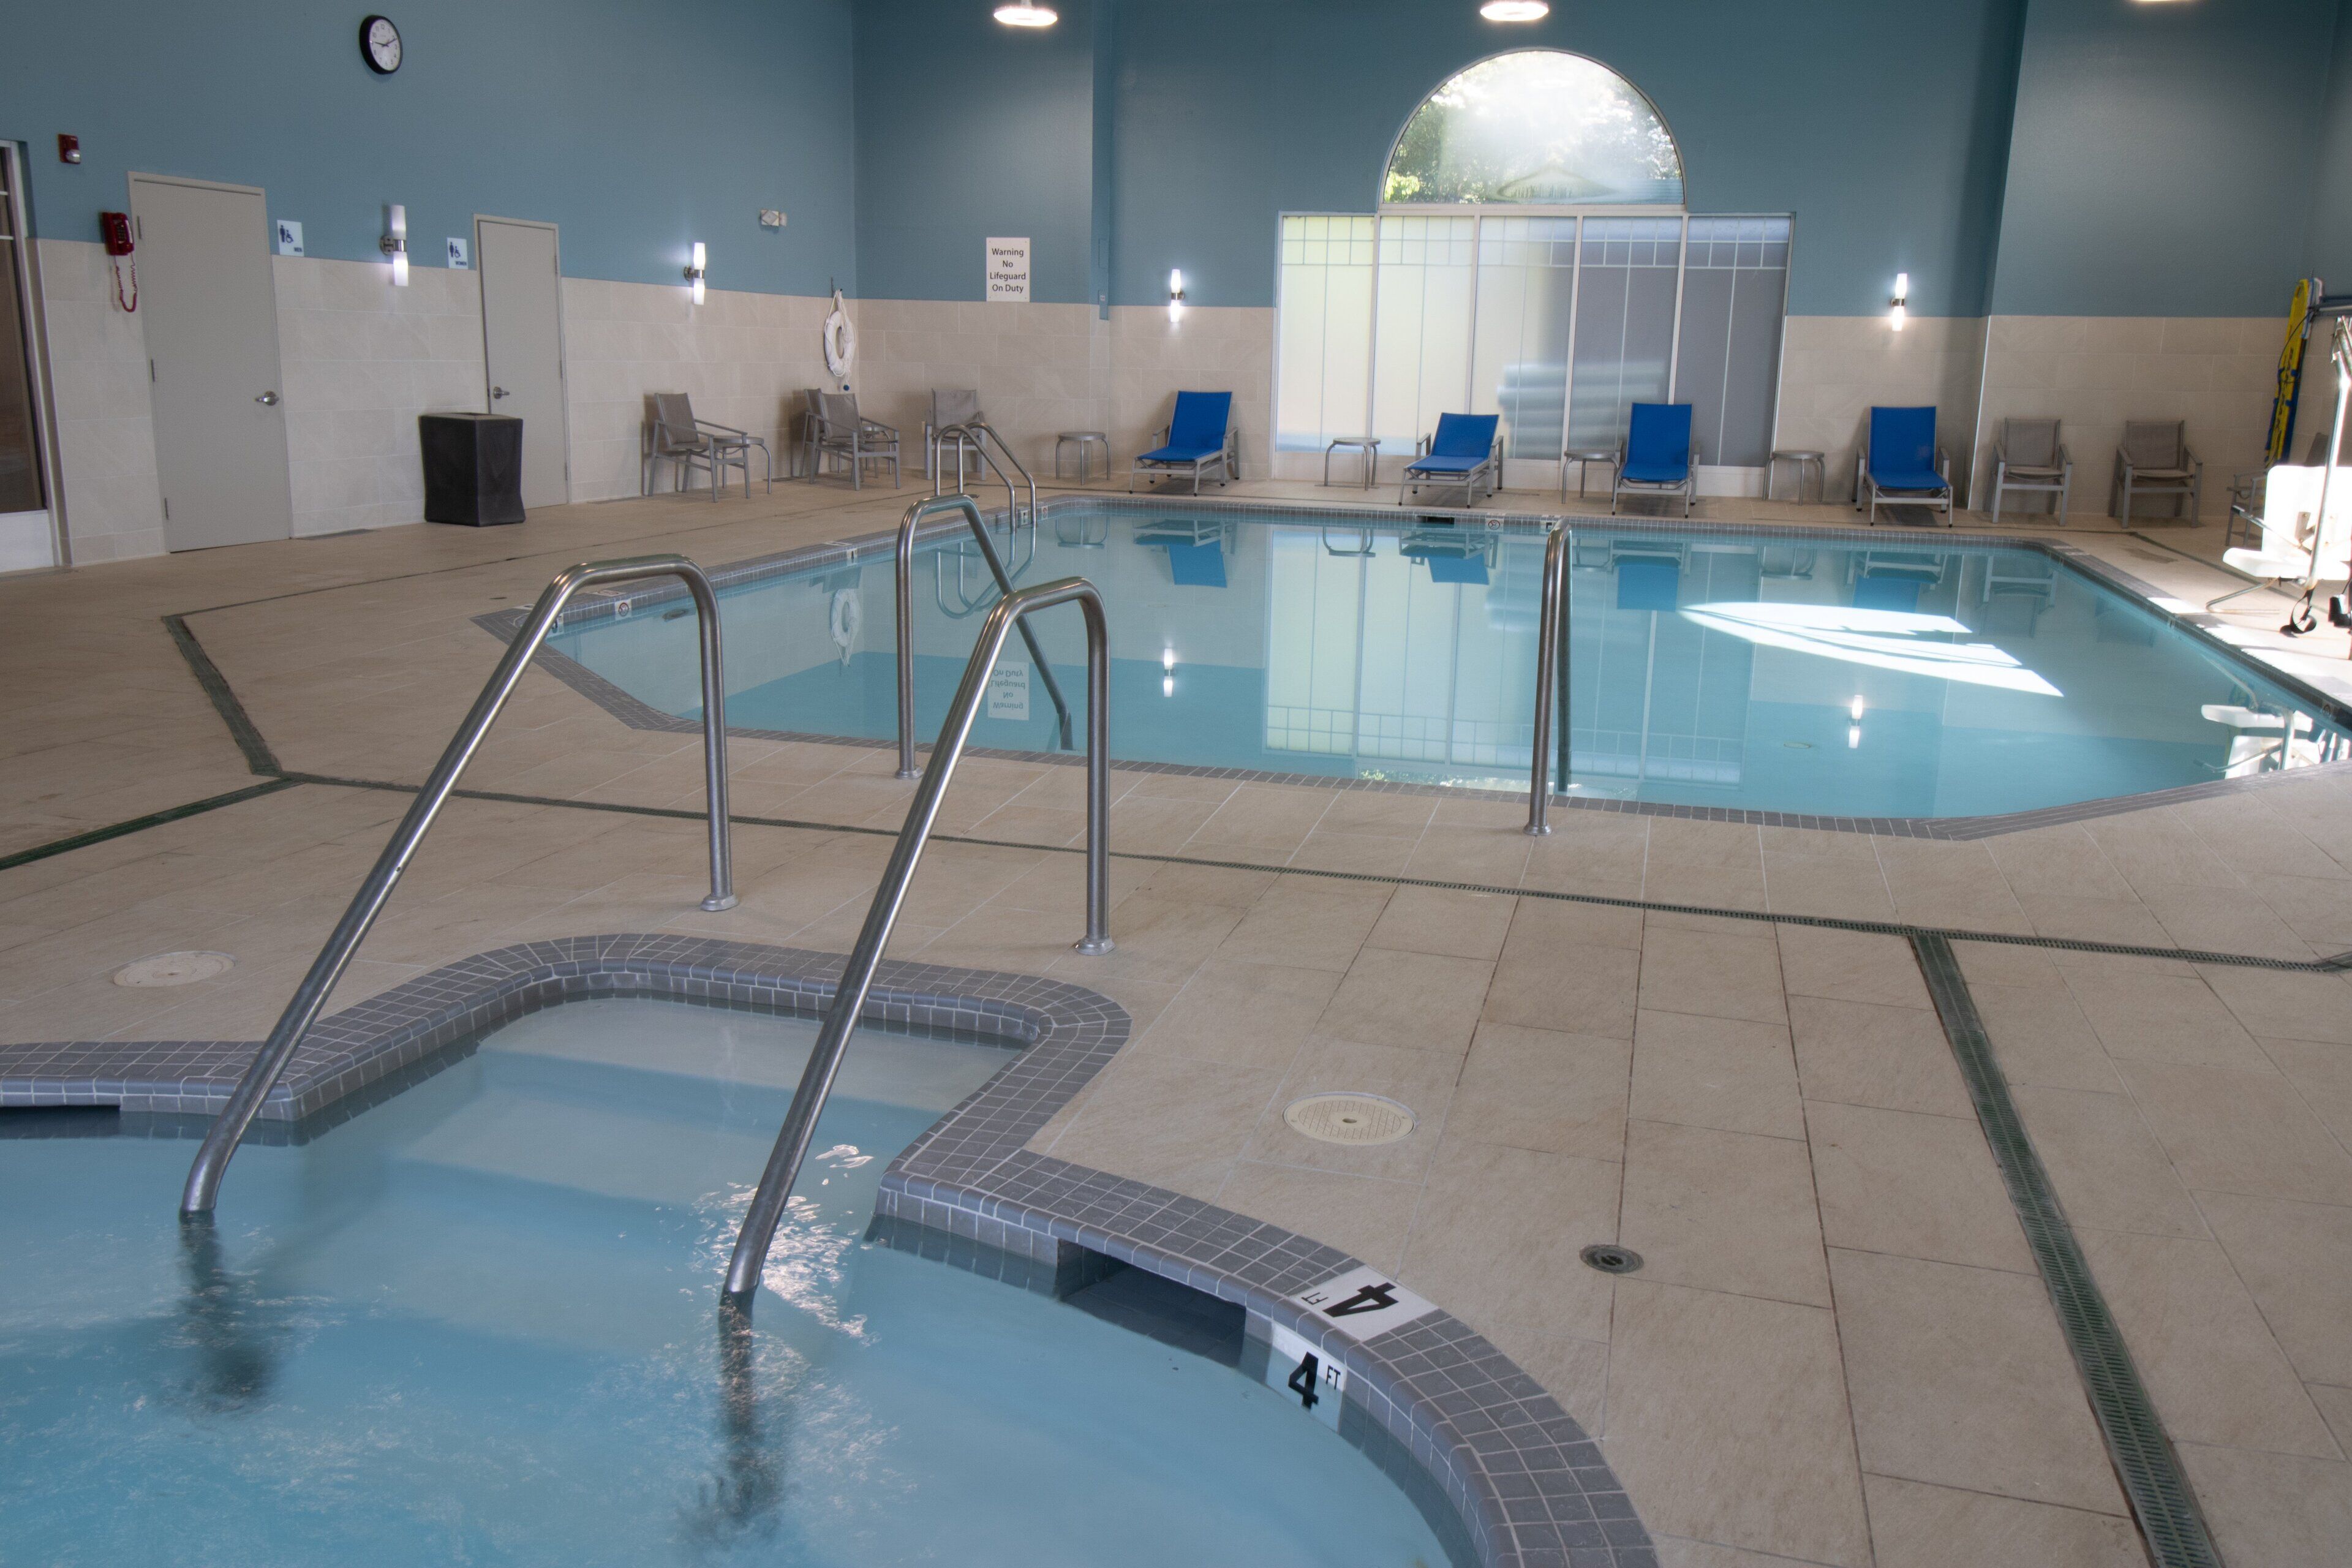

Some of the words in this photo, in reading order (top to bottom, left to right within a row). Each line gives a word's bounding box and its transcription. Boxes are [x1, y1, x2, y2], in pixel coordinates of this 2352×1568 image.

[992, 248, 1024, 257] Warning
[990, 272, 1026, 281] Lifeguard
[1005, 284, 1023, 293] Duty
[1301, 1292, 1329, 1305] FT
[1322, 1282, 1400, 1318] 4
[1287, 1351, 1319, 1411] 4
[1325, 1364, 1341, 1390] FT
